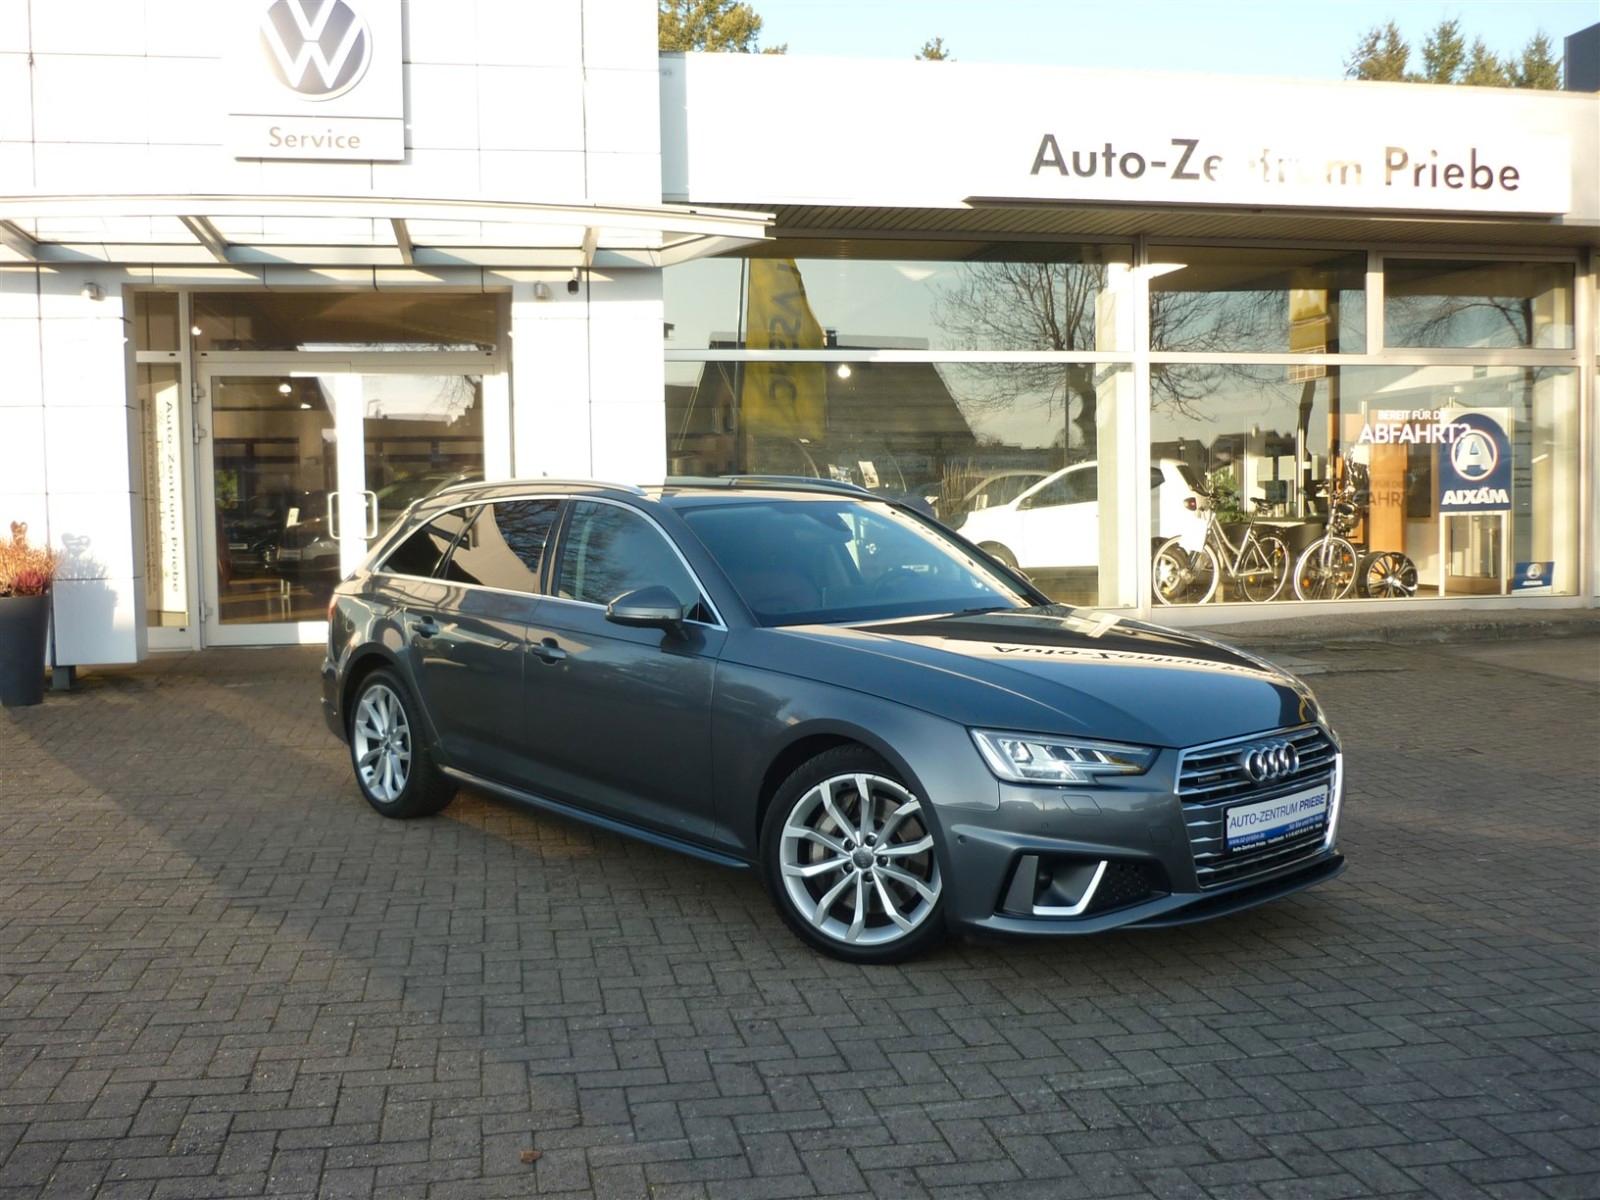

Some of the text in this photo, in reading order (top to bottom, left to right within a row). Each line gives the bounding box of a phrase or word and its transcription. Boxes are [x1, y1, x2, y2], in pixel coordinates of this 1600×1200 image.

[268, 126, 361, 149] Service
[1385, 146, 1520, 192] Priebe
[1377, 409, 1410, 421] BEREIT
[1411, 407, 1431, 421] FÜR
[1230, 802, 1298, 828] AUTO-ZENTRUM
[1299, 793, 1325, 811] PRIEBE
